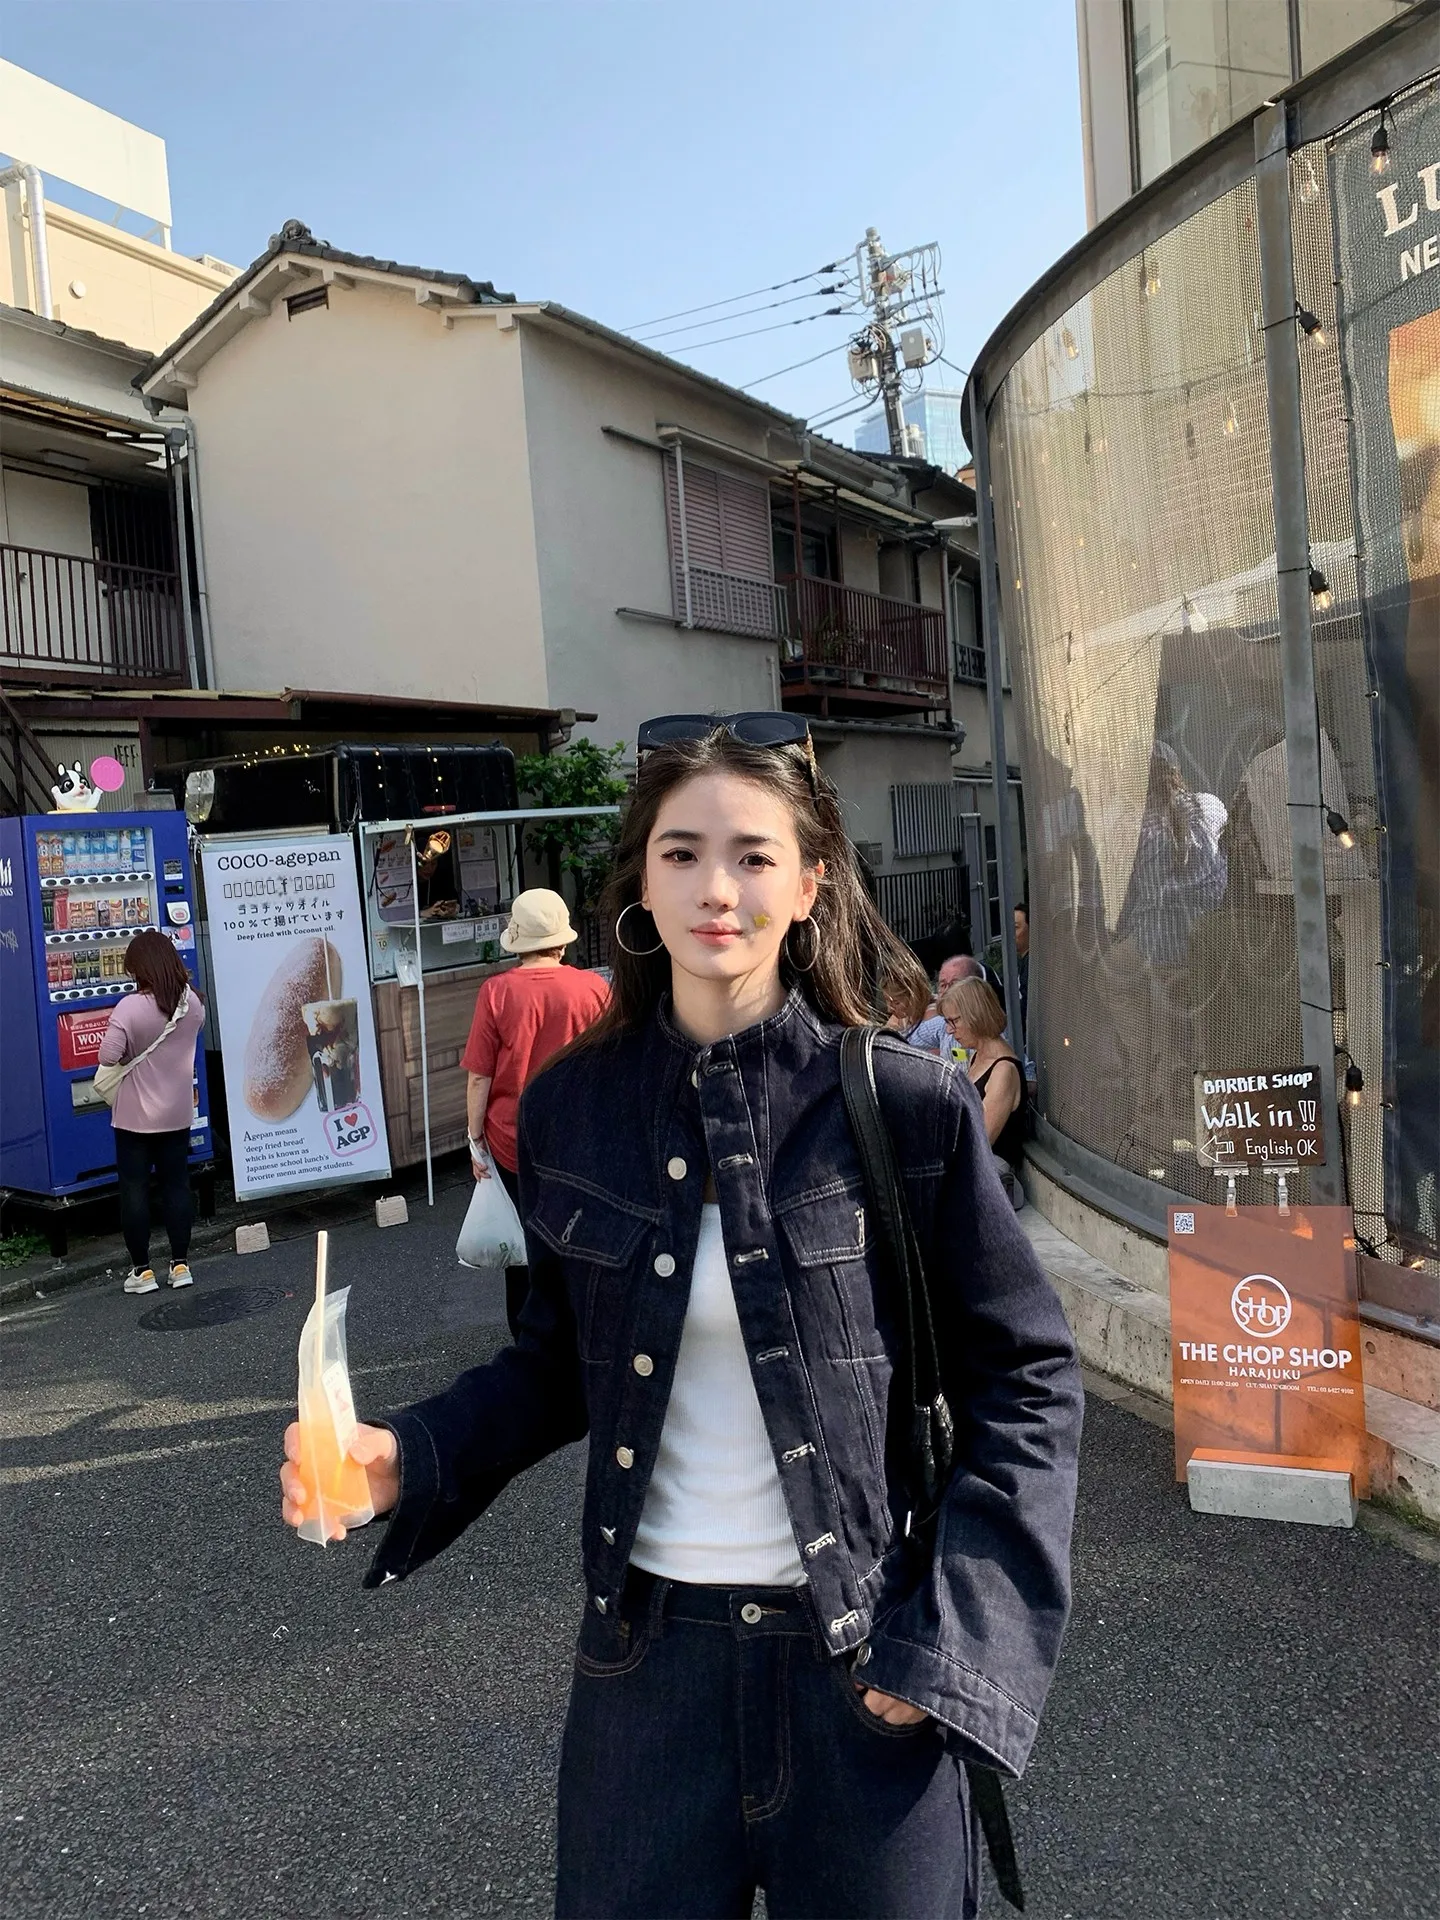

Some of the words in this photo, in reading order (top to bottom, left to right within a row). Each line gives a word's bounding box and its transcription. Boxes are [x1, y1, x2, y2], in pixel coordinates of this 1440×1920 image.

[217, 850, 341, 871] COCO-agepan
[237, 934, 255, 942] Deep
[294, 927, 322, 935] Coconut
[1203, 1075, 1269, 1095] BARBER
[1272, 1072, 1313, 1089] SHOP
[1200, 1101, 1261, 1130] Walk
[1267, 1104, 1293, 1128] in
[243, 1130, 274, 1142] Agepan
[274, 1127, 298, 1136] means
[336, 1125, 371, 1150] AGP
[245, 1152, 267, 1162] which
[268, 1152, 275, 1160] is
[276, 1149, 300, 1158] known
[264, 1142, 282, 1150] fried
[1246, 1138, 1293, 1161] English
[1297, 1139, 1318, 1156] OK
[246, 1162, 279, 1174] Japanese
[280, 1158, 303, 1168] school
[304, 1154, 330, 1164] lunch's
[246, 1173, 275, 1182] favorite
[276, 1170, 297, 1178] menu
[298, 1166, 323, 1174] among
[323, 1160, 355, 1171] students.
[1179, 1342, 1218, 1362] THE
[1222, 1344, 1285, 1365] CHOP
[1289, 1348, 1353, 1369] SHOP
[1229, 1366, 1301, 1381] HARAJUKU
